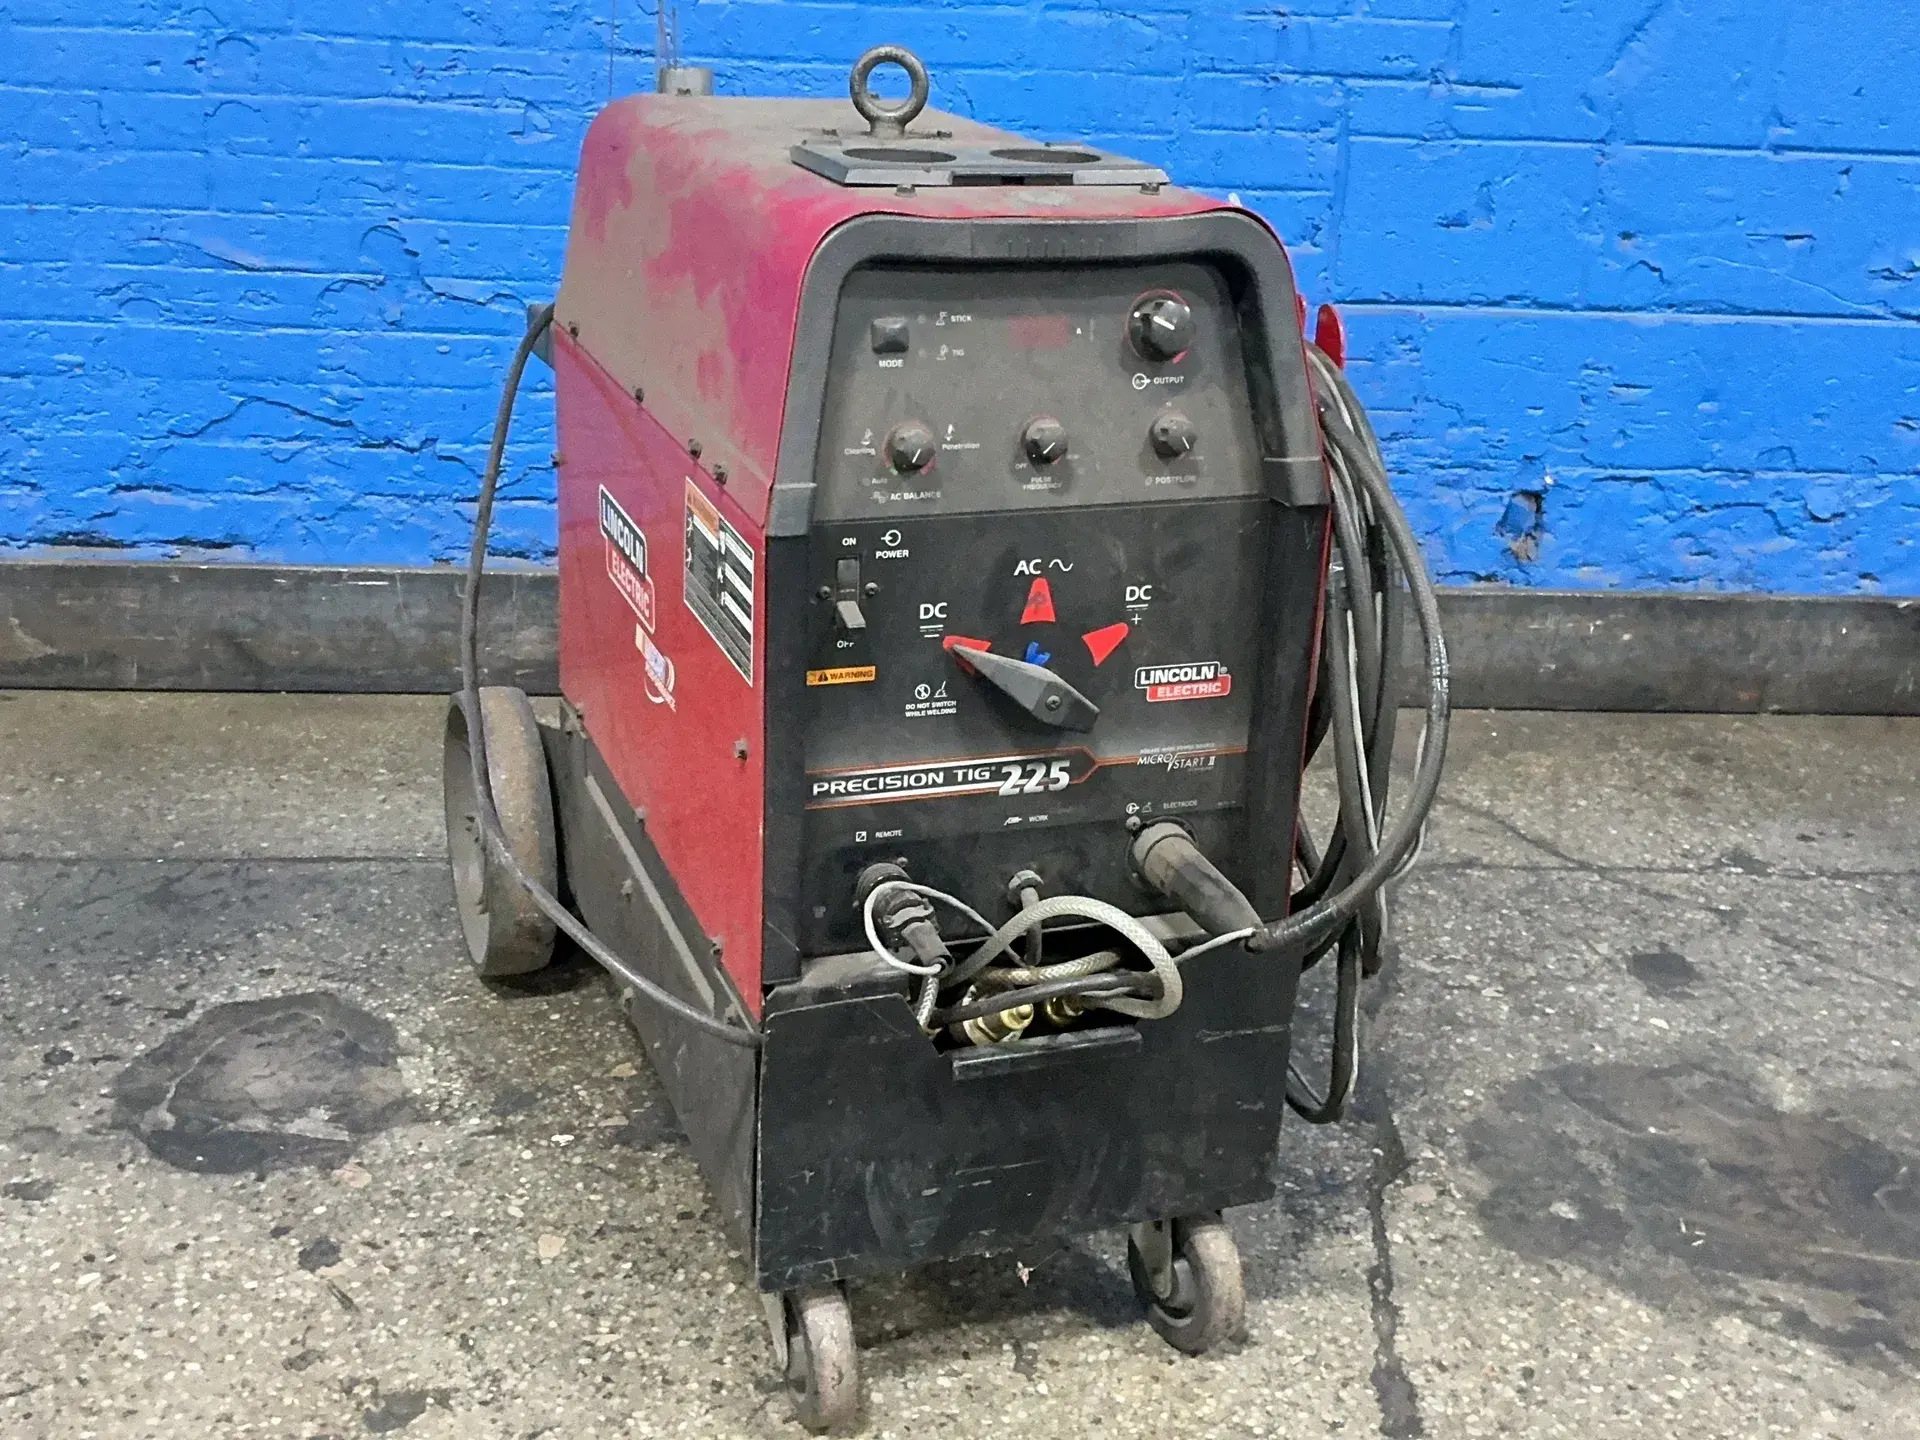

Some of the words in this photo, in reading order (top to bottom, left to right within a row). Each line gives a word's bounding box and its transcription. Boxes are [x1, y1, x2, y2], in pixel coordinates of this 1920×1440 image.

[951, 314, 973, 323] STICK
[952, 348, 965, 357] TIG
[878, 359, 905, 368] MODE
[1153, 374, 1185, 386] OUTPUT
[890, 491, 901, 502] AC
[903, 490, 942, 500] BALANCE
[601, 498, 644, 574] LINCOLN
[842, 536, 857, 547] ON
[875, 549, 910, 560] POWER
[1013, 558, 1043, 577] AC
[611, 550, 651, 618] ELECTRIC
[1125, 584, 1153, 602] DC
[919, 602, 948, 620] DC
[830, 669, 875, 681] WARNING
[1140, 664, 1215, 686] LINCOLN
[1157, 681, 1222, 698] ELECTRIC
[905, 703, 917, 711] DO
[917, 702, 931, 710] NOT
[931, 700, 957, 708] SWITCH
[905, 710, 926, 718] WHILE
[926, 708, 957, 717] WELDING
[812, 770, 945, 796] PRECISION
[955, 767, 990, 784] TIG
[997, 759, 1071, 797] 225
[1163, 799, 1198, 810] ELECTRODE
[1028, 814, 1049, 823] WORK
[874, 829, 903, 839] REMOTE
